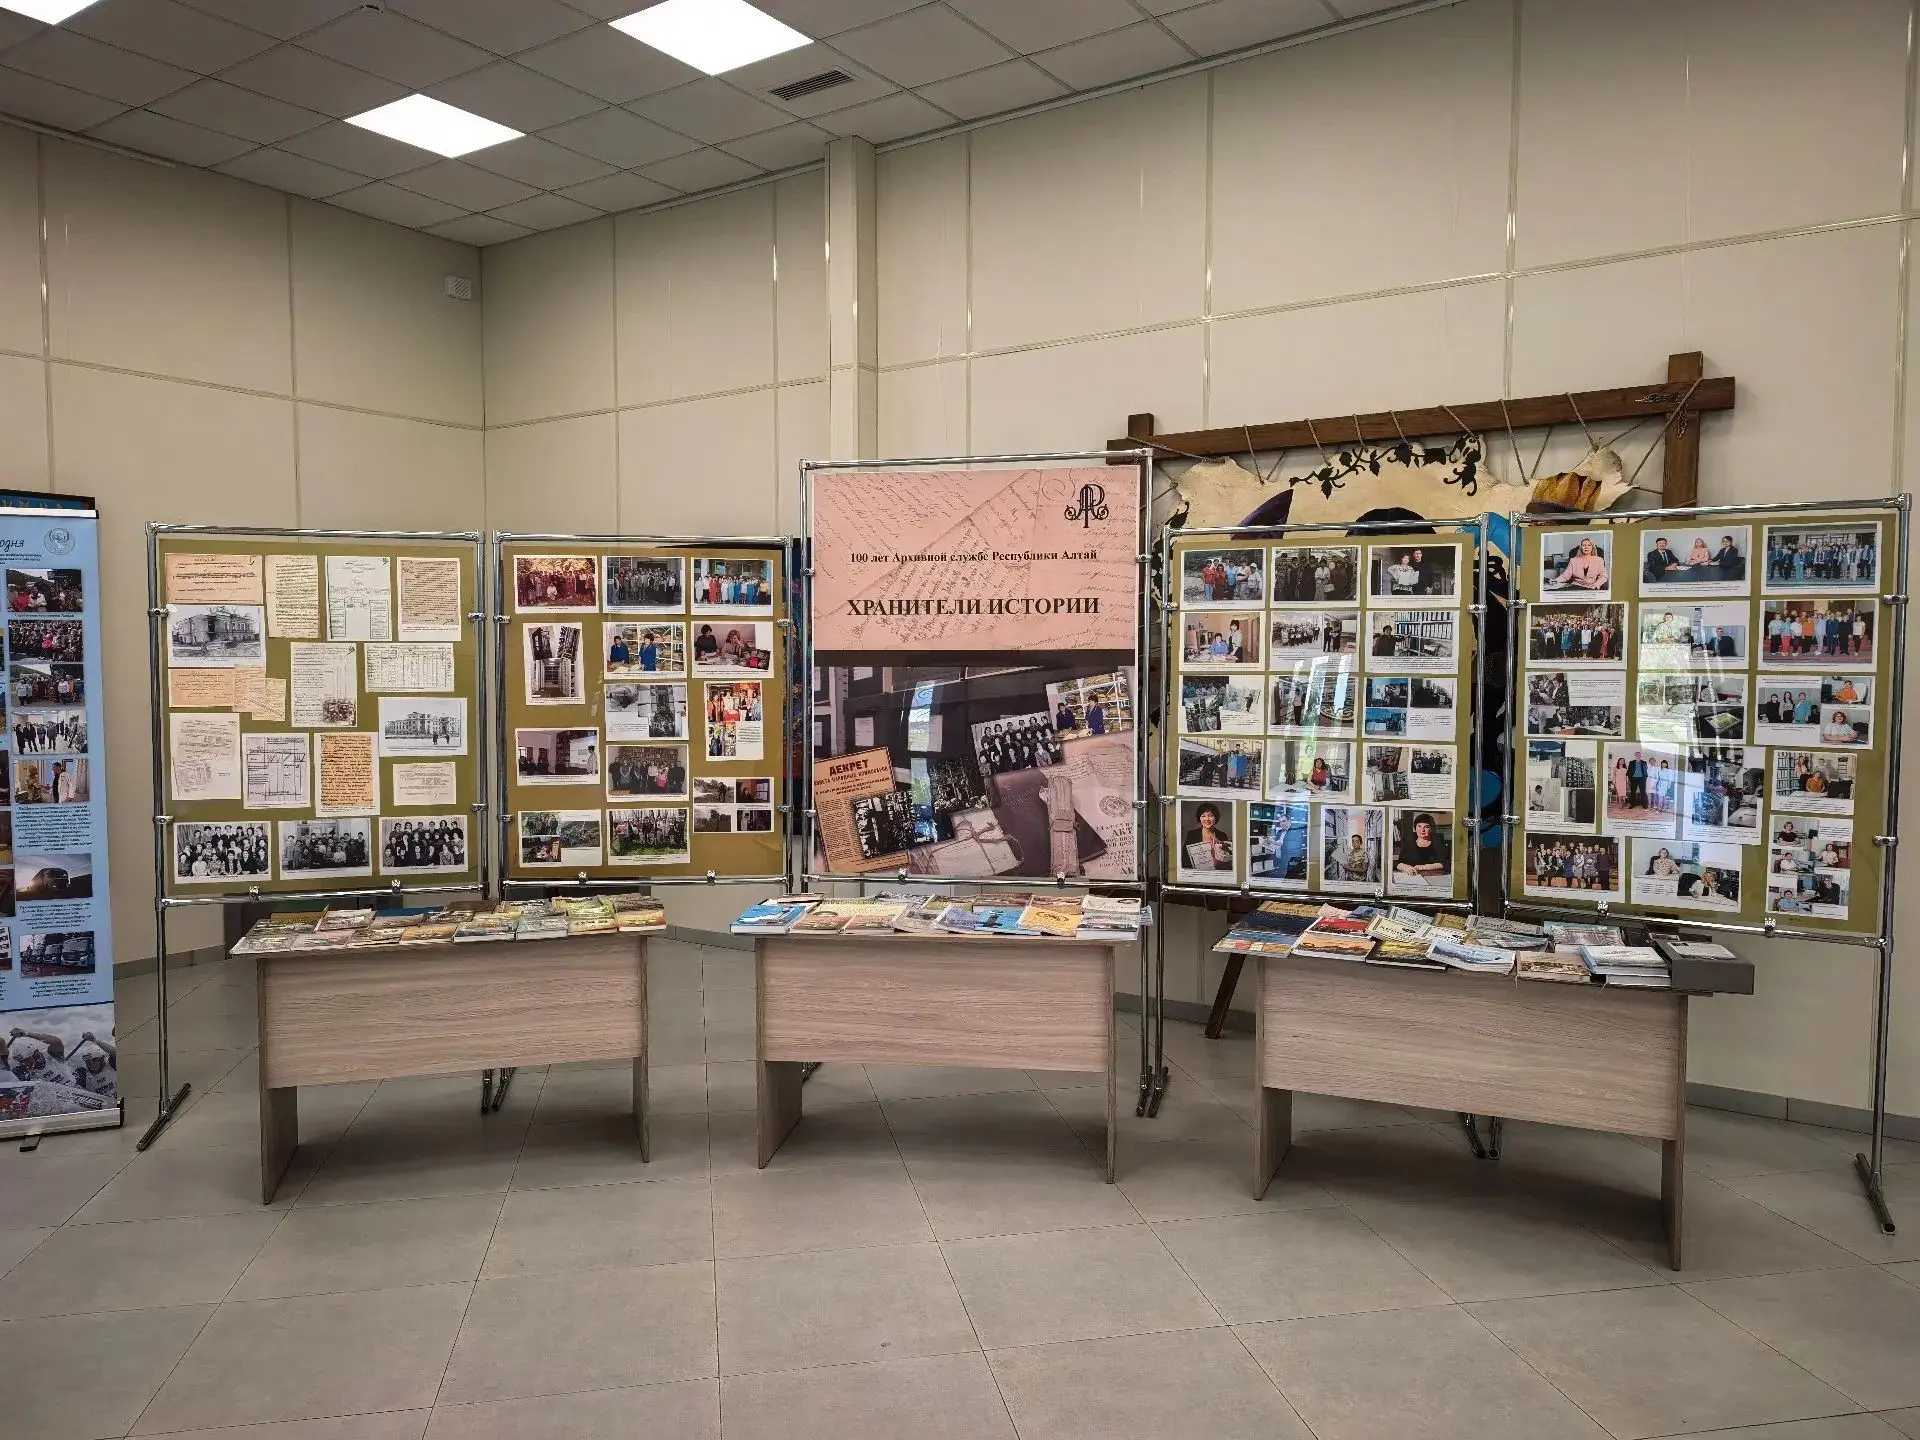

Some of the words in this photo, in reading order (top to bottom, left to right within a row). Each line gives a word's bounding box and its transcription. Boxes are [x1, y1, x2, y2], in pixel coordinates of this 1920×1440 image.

[850, 552, 868, 563] 100
[870, 555, 890, 563] лет
[892, 552, 947, 566] Архивной
[950, 551, 989, 565] службе
[992, 550, 1058, 565] Республики
[1060, 549, 1098, 562] Алтай
[847, 597, 982, 616] ХРАНИТЕЛИ
[988, 596, 1101, 615] ИСТОРИИ
[829, 759, 869, 776] ДЕКРЕТ
